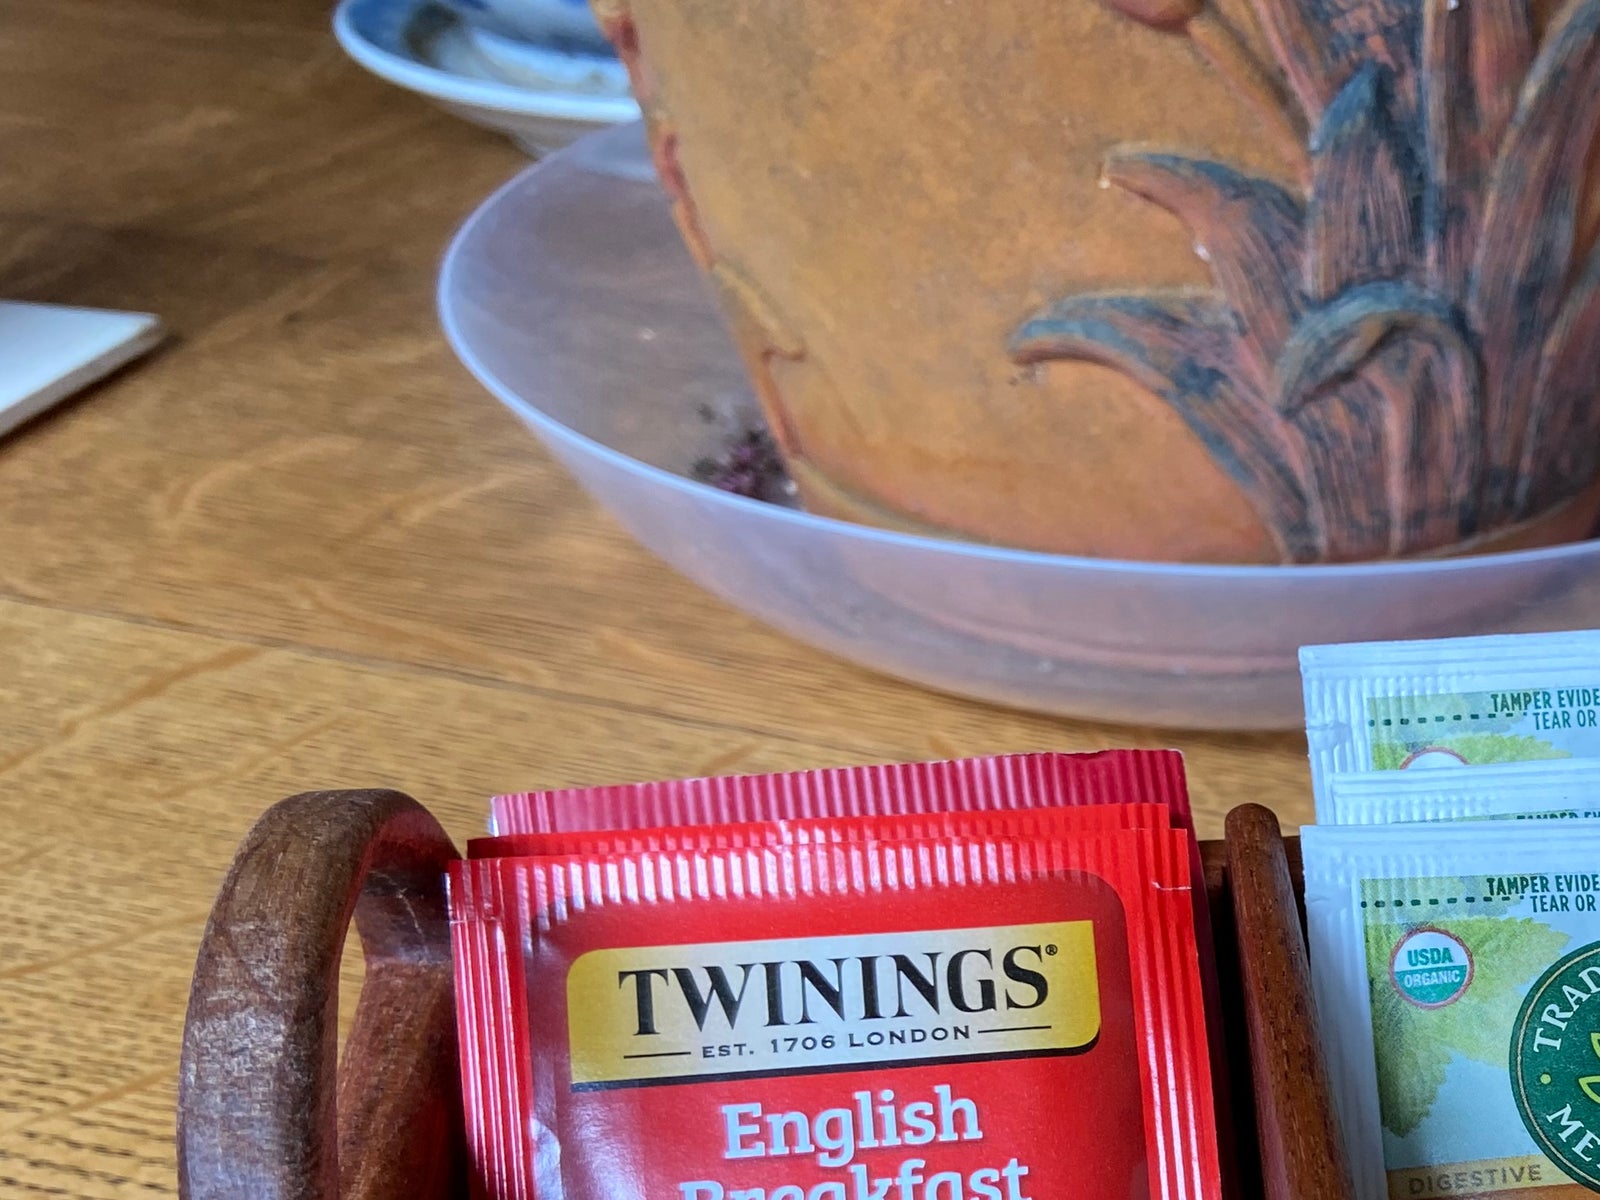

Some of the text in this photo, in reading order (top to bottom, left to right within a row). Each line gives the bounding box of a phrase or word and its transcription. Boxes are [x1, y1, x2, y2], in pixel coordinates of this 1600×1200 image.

[1490, 691, 1552, 713] TAMPER
[1533, 711, 1572, 730] TEAR
[1577, 709, 1597, 727] OR
[1486, 874, 1551, 897] TAMPER
[1529, 894, 1570, 913] TEAR
[1575, 892, 1597, 912] OR
[1407, 947, 1453, 967] USDA
[1404, 970, 1460, 988] ORGANIC
[702, 1025, 971, 1060] EST. 1706 LONDON
[720, 1083, 983, 1167] English
[1409, 1163, 1542, 1195] DIGESTIVE
